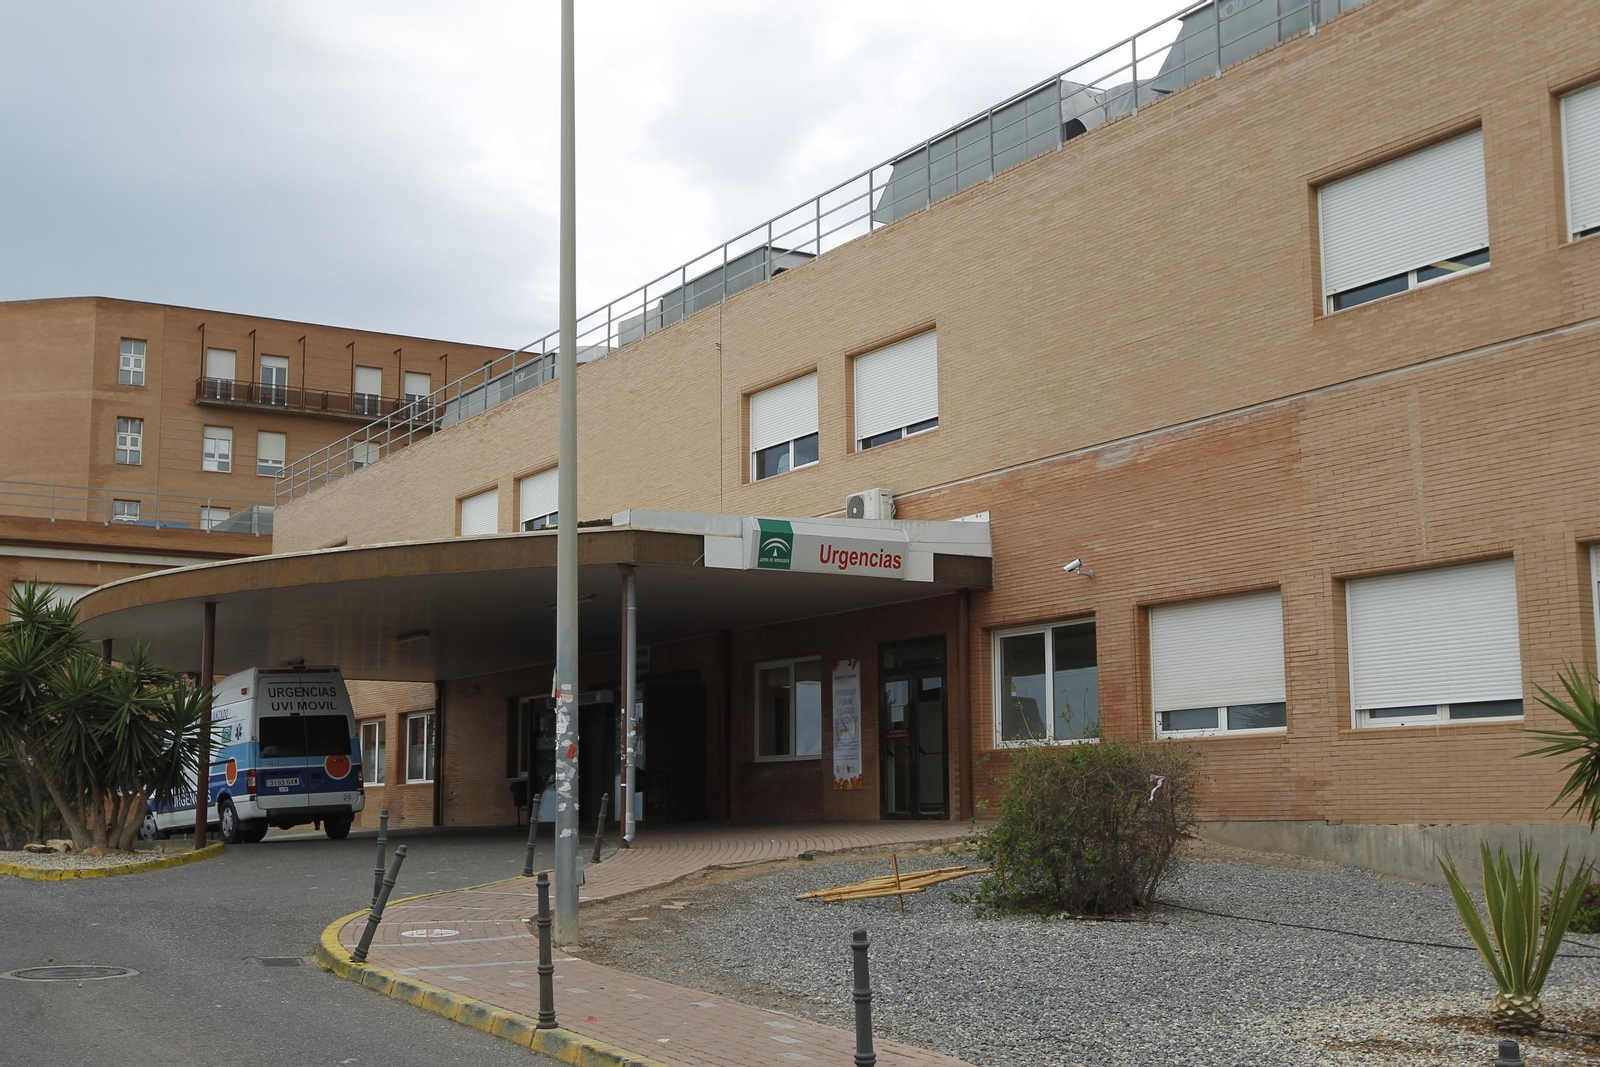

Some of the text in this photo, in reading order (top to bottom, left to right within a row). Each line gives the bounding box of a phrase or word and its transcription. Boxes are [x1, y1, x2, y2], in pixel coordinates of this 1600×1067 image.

[818, 543, 902, 571] Urgencias
[268, 686, 337, 698] URGENCIAS
[271, 701, 338, 711] UVI MOVIL
